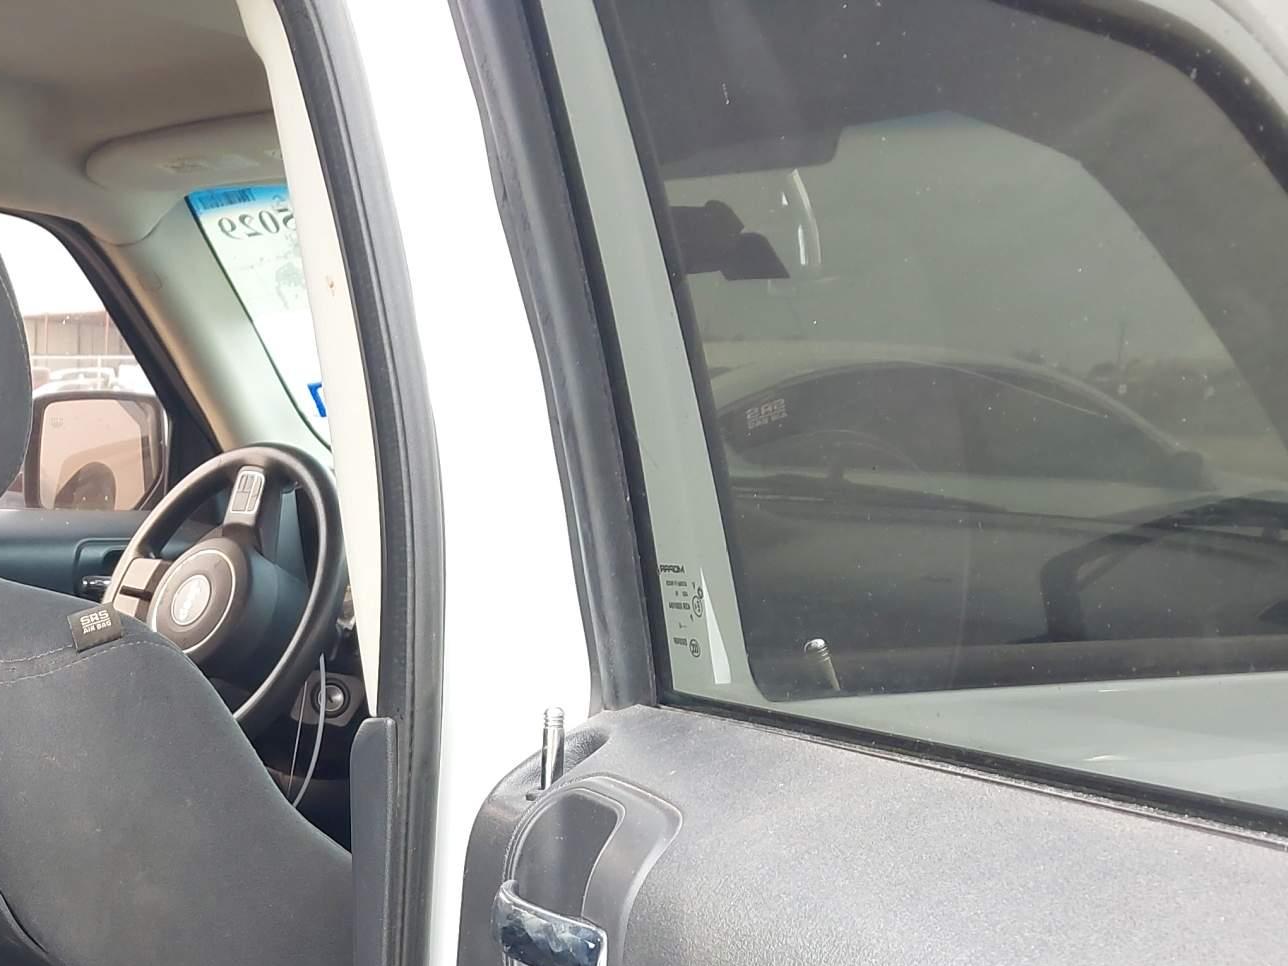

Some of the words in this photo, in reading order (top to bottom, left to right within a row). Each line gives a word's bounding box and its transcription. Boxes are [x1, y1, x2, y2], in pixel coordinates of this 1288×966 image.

[80, 610, 109, 625] SRS
[82, 625, 96, 635] AIR
[97, 619, 112, 630] BAG
